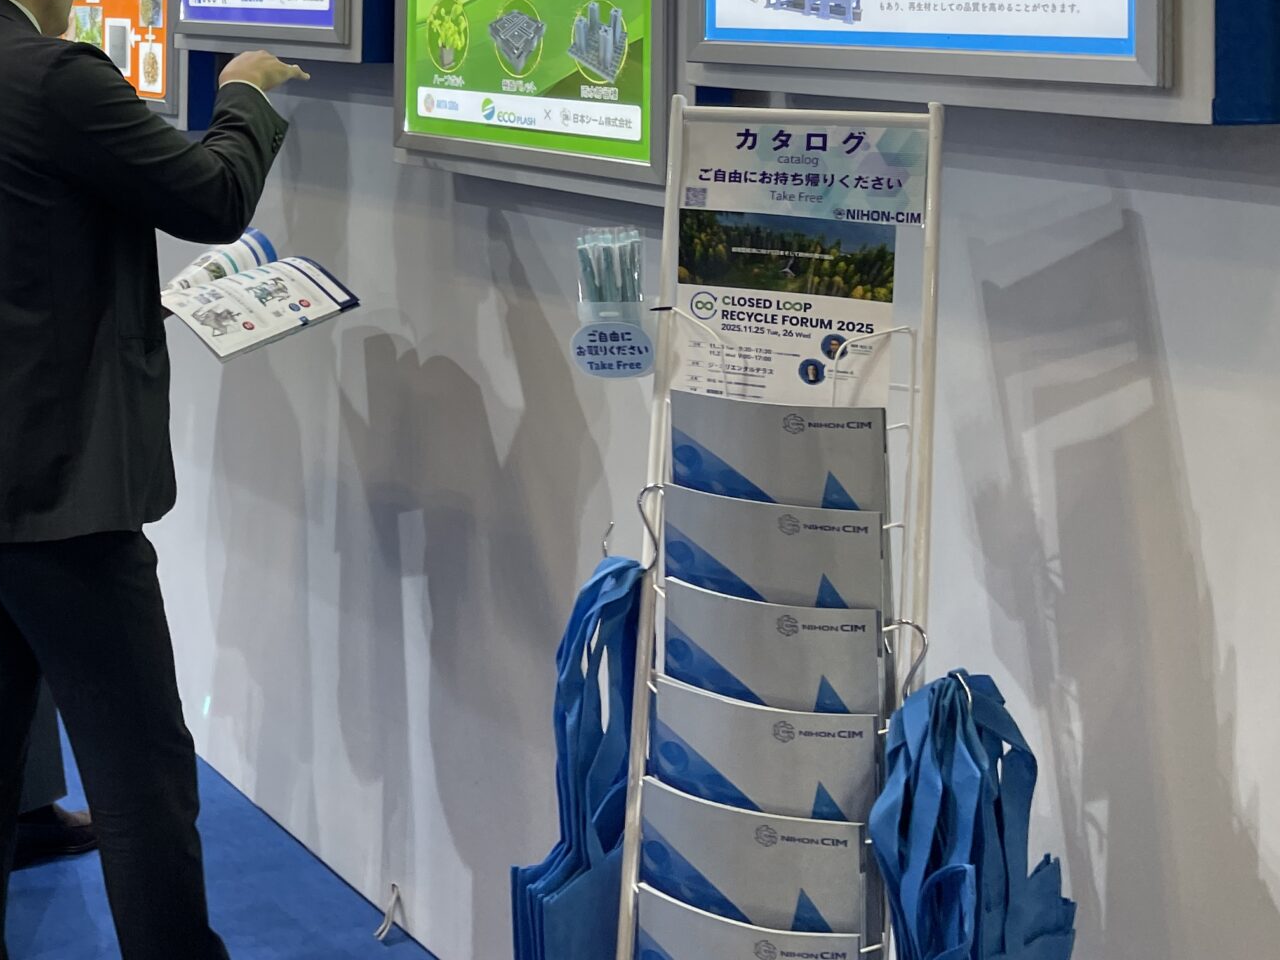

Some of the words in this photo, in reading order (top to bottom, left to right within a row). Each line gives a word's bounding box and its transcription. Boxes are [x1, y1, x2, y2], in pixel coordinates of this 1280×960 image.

[497, 111, 515, 124] ECO
[572, 111, 633, 129] 日本シーム株式会社
[736, 128, 866, 154] カタログ
[777, 154, 819, 167] catalog
[698, 168, 903, 190] ご自由にお持ち帰りください
[770, 190, 796, 202] Take
[799, 192, 823, 203] Free
[846, 209, 921, 224] NIHON-CIM
[722, 295, 773, 310] CLOSED
[721, 309, 779, 325] RECYCLE
[782, 314, 833, 330] FORUM
[837, 320, 875, 334] 2025
[587, 330, 633, 343] ご自由に
[721, 323, 765, 335] 2025.11.25
[782, 329, 794, 338] 26
[576, 344, 649, 357] お取りください
[587, 360, 613, 370] Take
[616, 360, 642, 370] Free
[708, 362, 774, 375] ジ・リエンタルテラス
[808, 421, 845, 429] NIHON
[846, 421, 872, 429] CIM
[803, 524, 840, 532] NIHON
[842, 524, 869, 534] CIM
[801, 624, 839, 632] NIHON
[840, 623, 866, 632] CIM
[798, 730, 836, 738] NIHON
[837, 730, 864, 739] CIM
[780, 836, 819, 845] NIHON
[821, 837, 848, 847] CIM
[780, 951, 818, 959] NIHON
[820, 951, 847, 960] CIM
